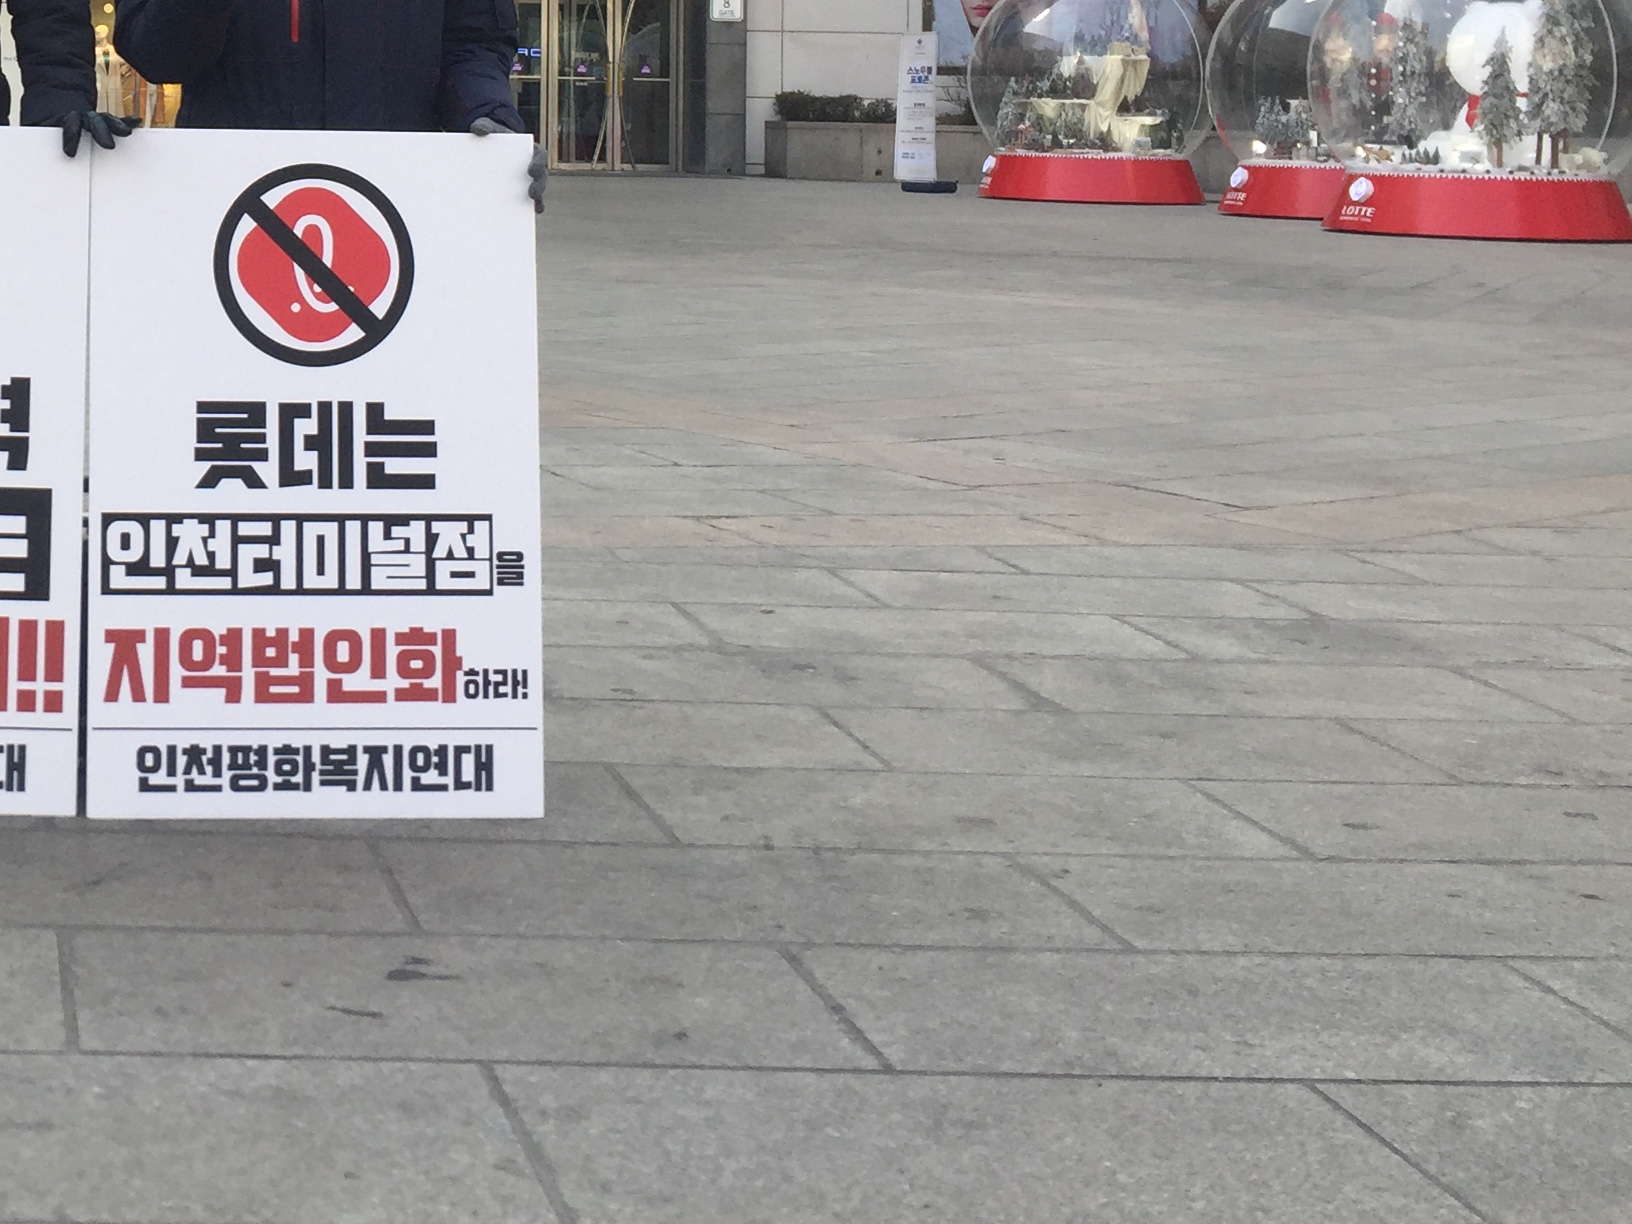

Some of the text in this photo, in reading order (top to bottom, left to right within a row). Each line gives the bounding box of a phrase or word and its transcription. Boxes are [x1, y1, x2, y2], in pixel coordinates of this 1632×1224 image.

[1341, 205, 1376, 217] LOTTE
[194, 400, 437, 490] 롯데는
[136, 743, 494, 792] 인천평화복지연대
